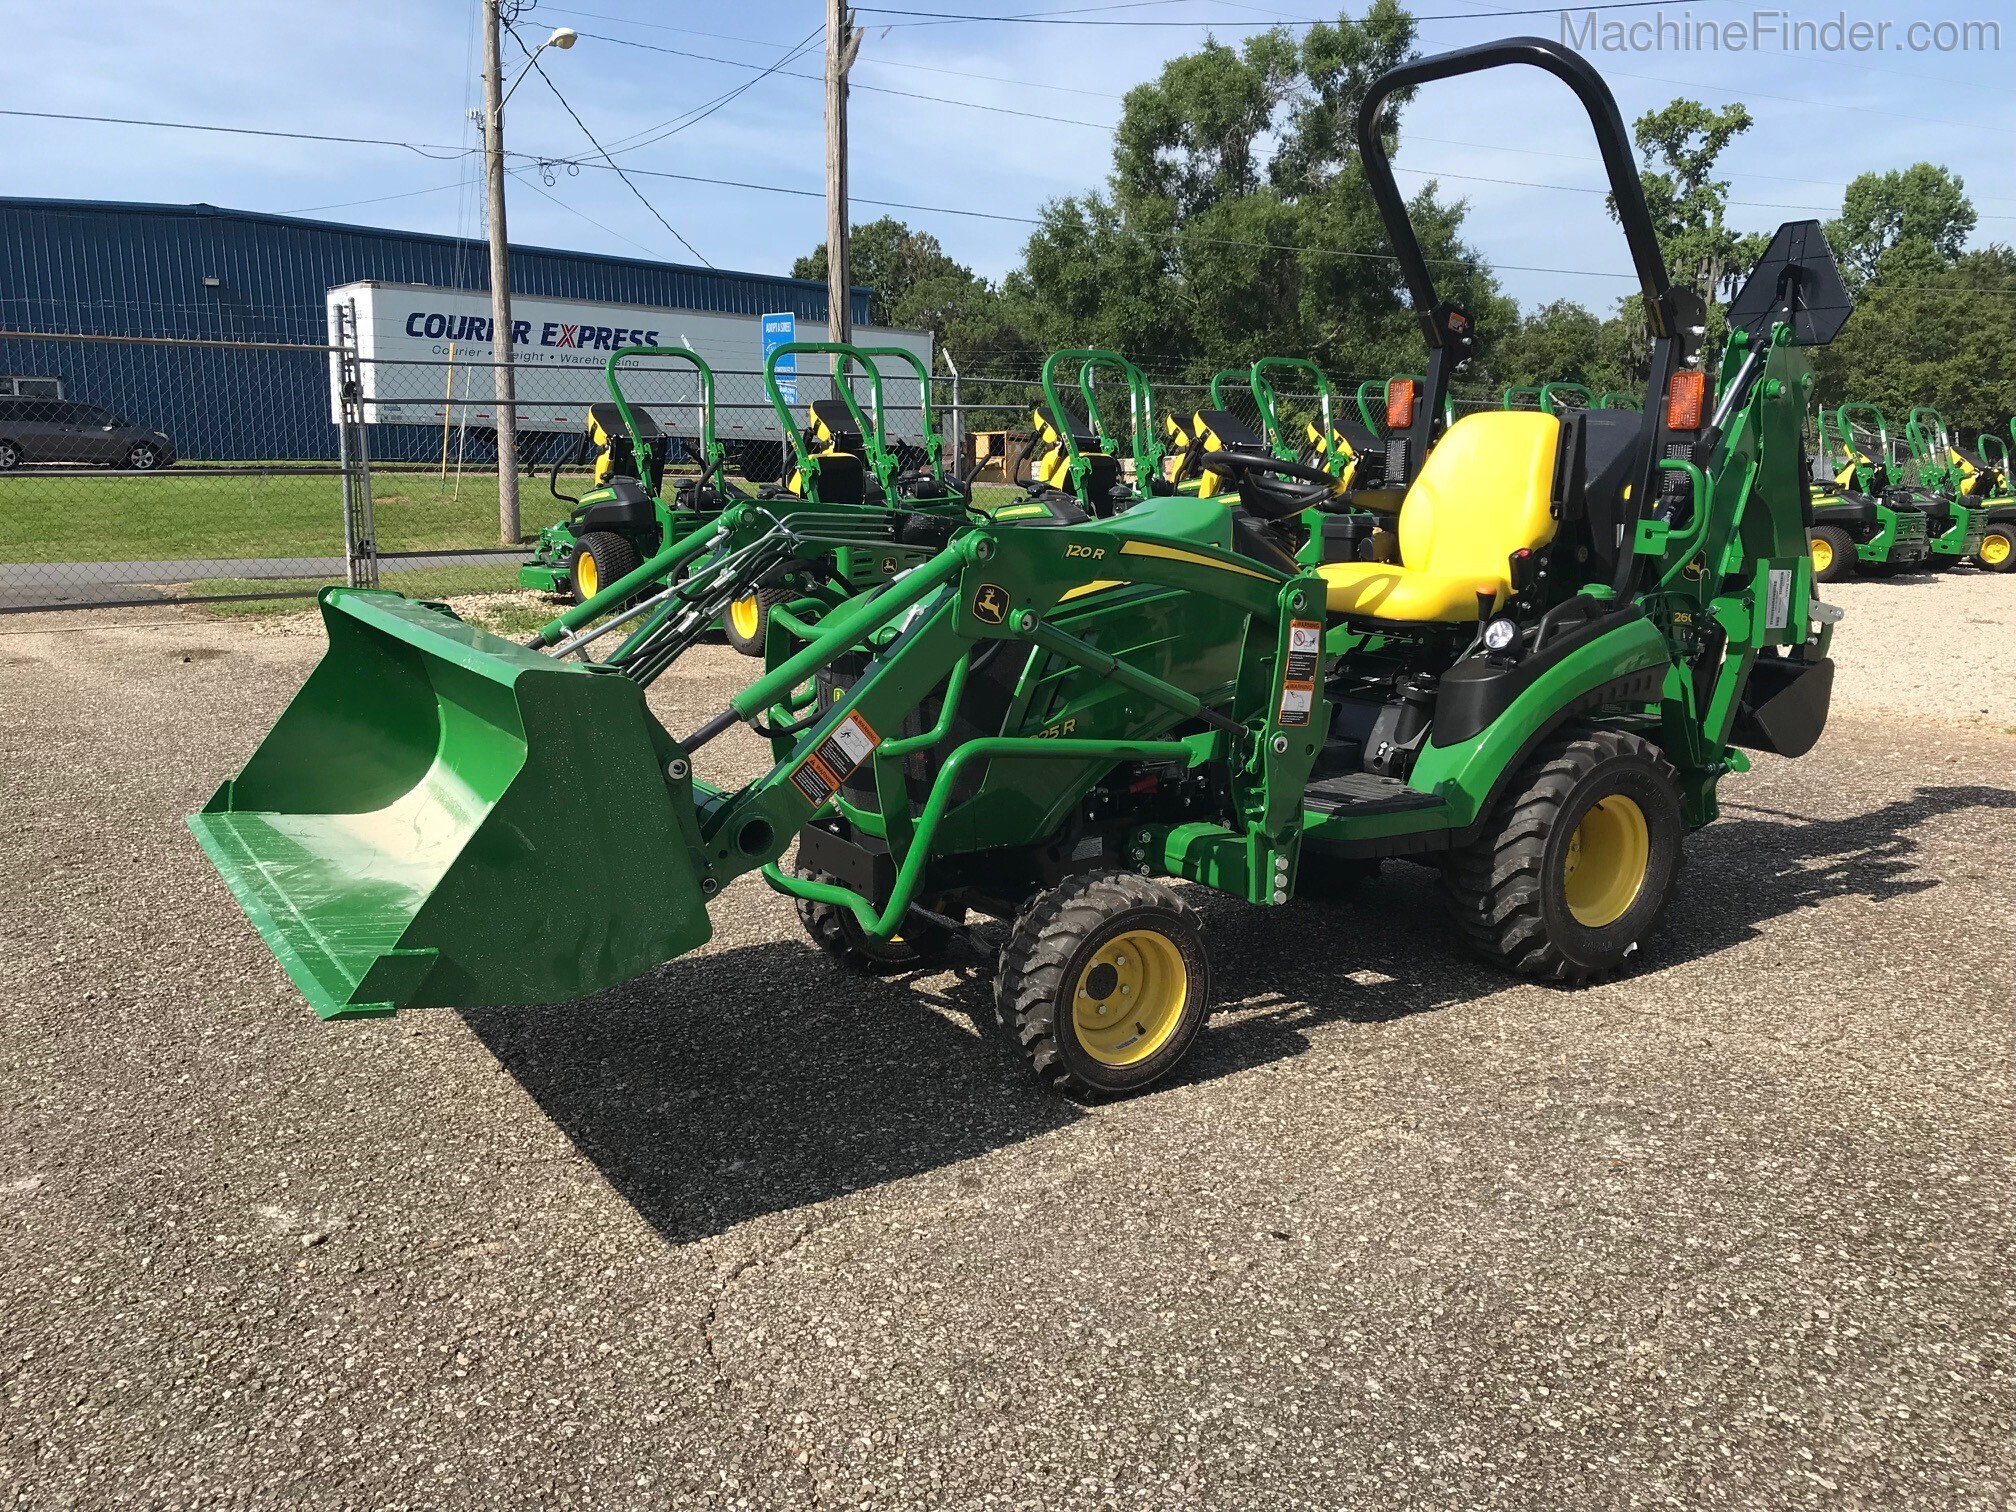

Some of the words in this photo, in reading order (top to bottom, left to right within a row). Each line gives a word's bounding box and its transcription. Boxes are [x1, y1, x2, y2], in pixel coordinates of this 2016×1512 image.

[405, 312, 531, 344] COURIR
[540, 322, 659, 350] EXPRESS
[510, 351, 545, 363] eight
[560, 353, 640, 367] Warehosing
[1065, 544, 1092, 558] 120
[1092, 548, 1105, 560] R
[1062, 718, 1076, 736] R
